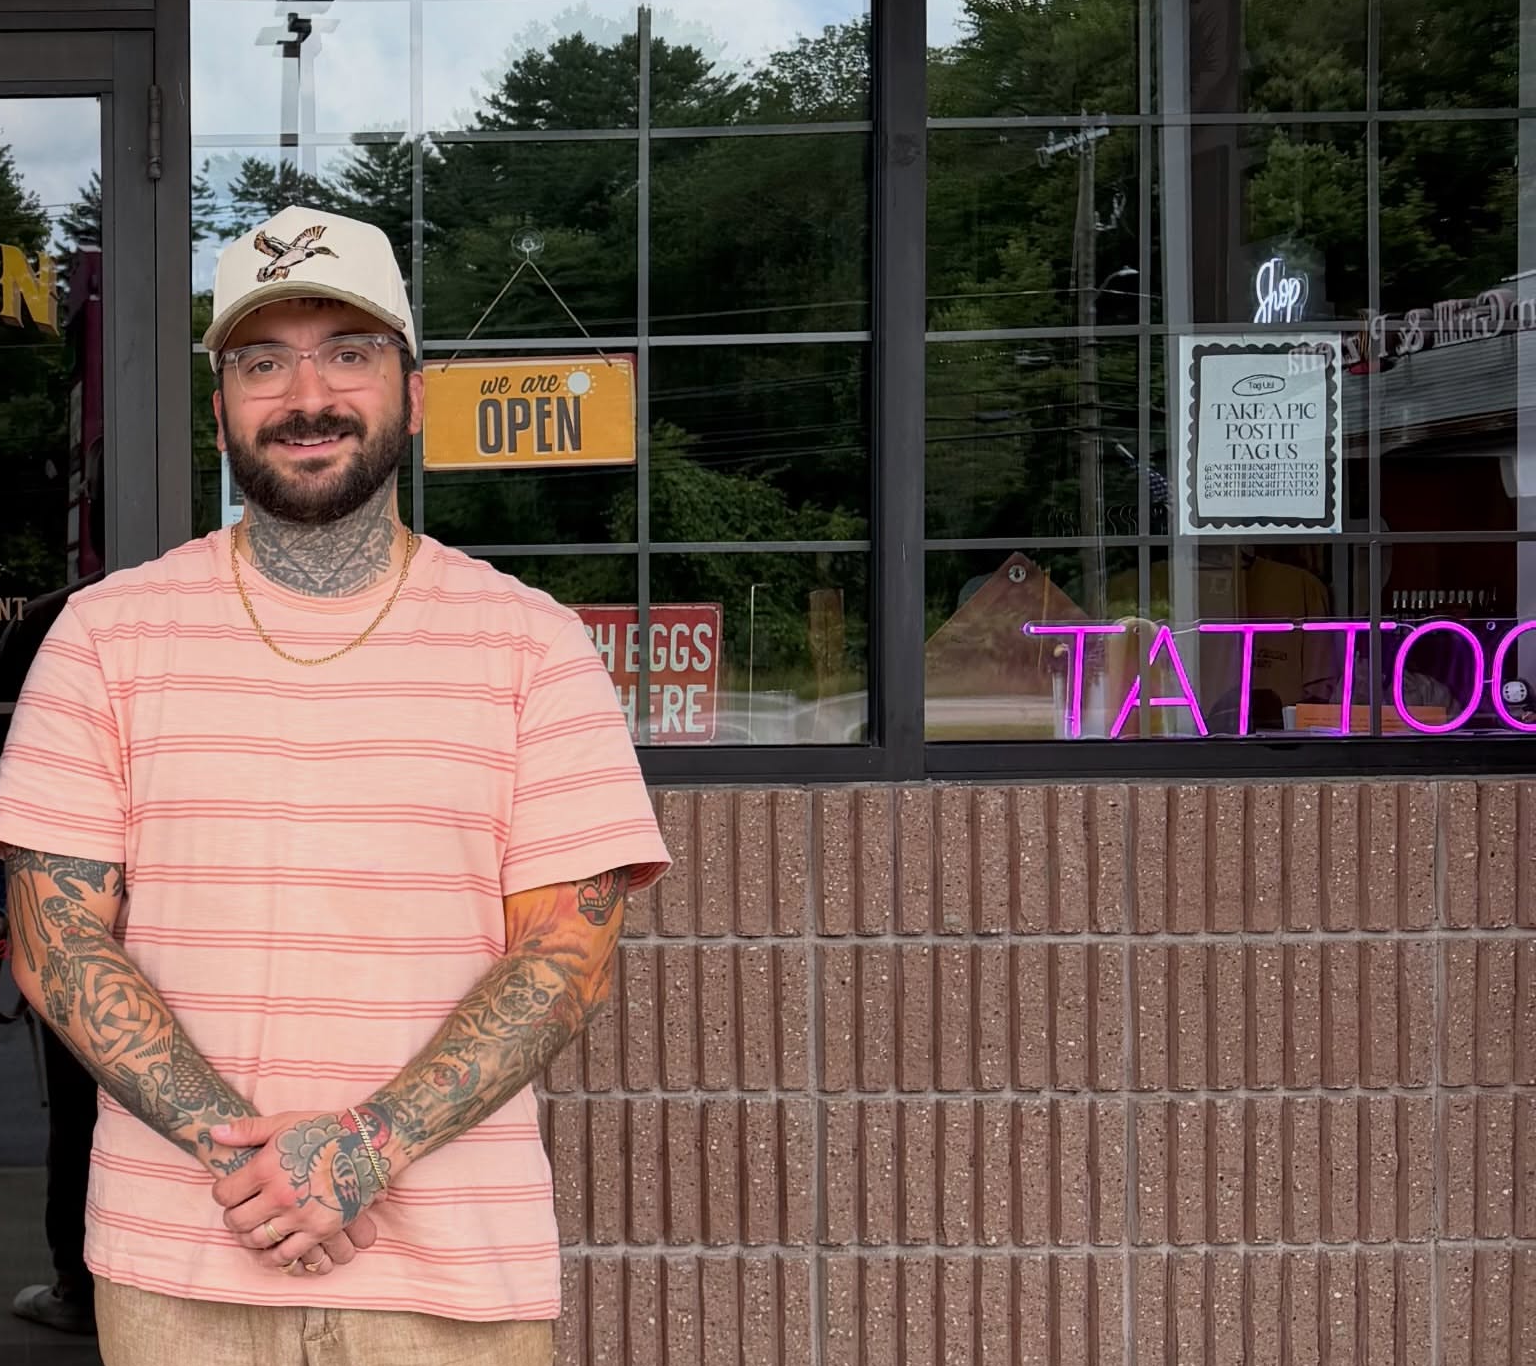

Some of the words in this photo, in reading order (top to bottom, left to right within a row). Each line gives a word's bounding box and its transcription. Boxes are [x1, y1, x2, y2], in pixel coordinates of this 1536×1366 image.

[480, 375, 512, 396] we
[521, 373, 561, 395] are
[1211, 402, 1265, 420] TAKE
[1268, 402, 1283, 420] A
[1287, 402, 1317, 420] PIC
[477, 395, 583, 455] OPEN
[1225, 422, 1278, 440] POST
[1280, 422, 1301, 440] IT
[1226, 443, 1270, 461] TAG
[1274, 443, 1299, 461] US
[625, 622, 713, 673] EGGS
